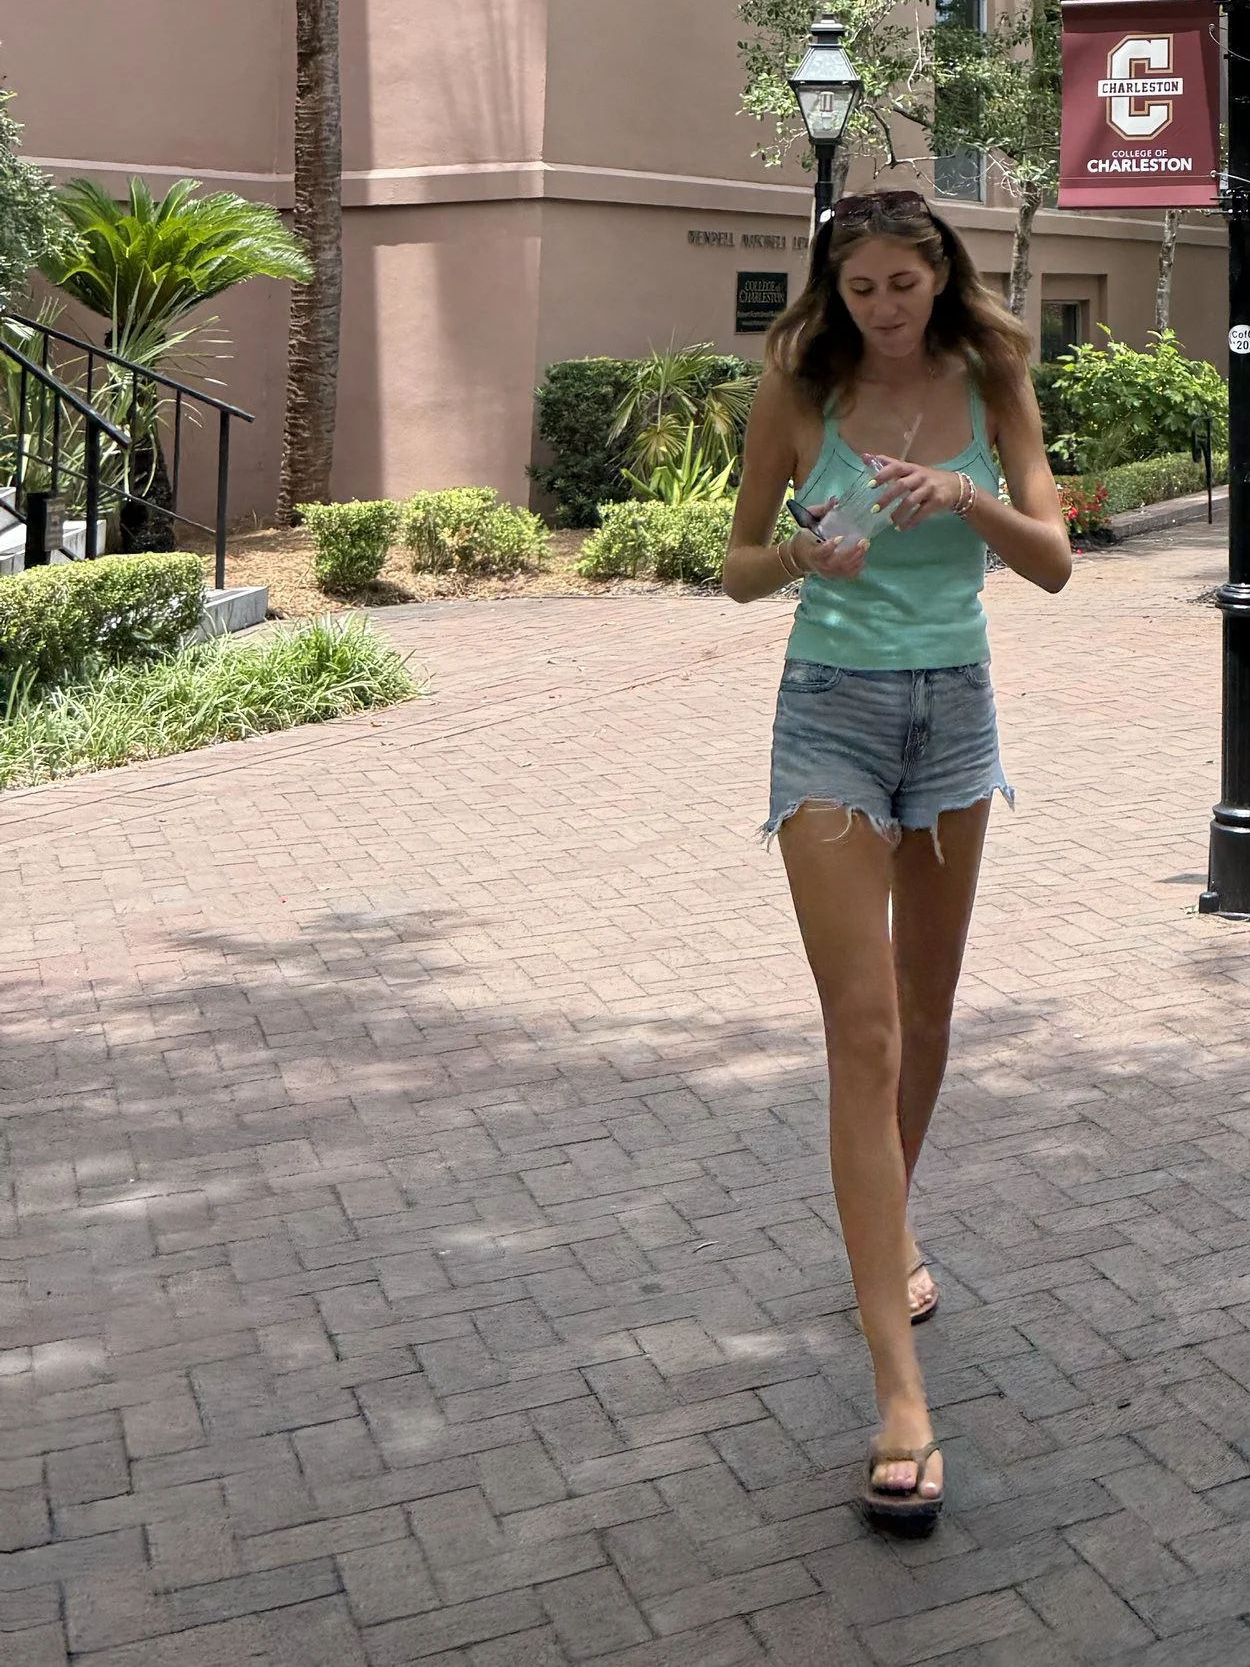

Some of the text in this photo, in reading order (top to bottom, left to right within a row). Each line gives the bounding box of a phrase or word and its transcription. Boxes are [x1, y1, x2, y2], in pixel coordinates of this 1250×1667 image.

[1102, 81, 1179, 94] CHARLESTON
[1111, 149, 1168, 158] COLLEGE OF
[1087, 157, 1193, 173] CHARLESTON
